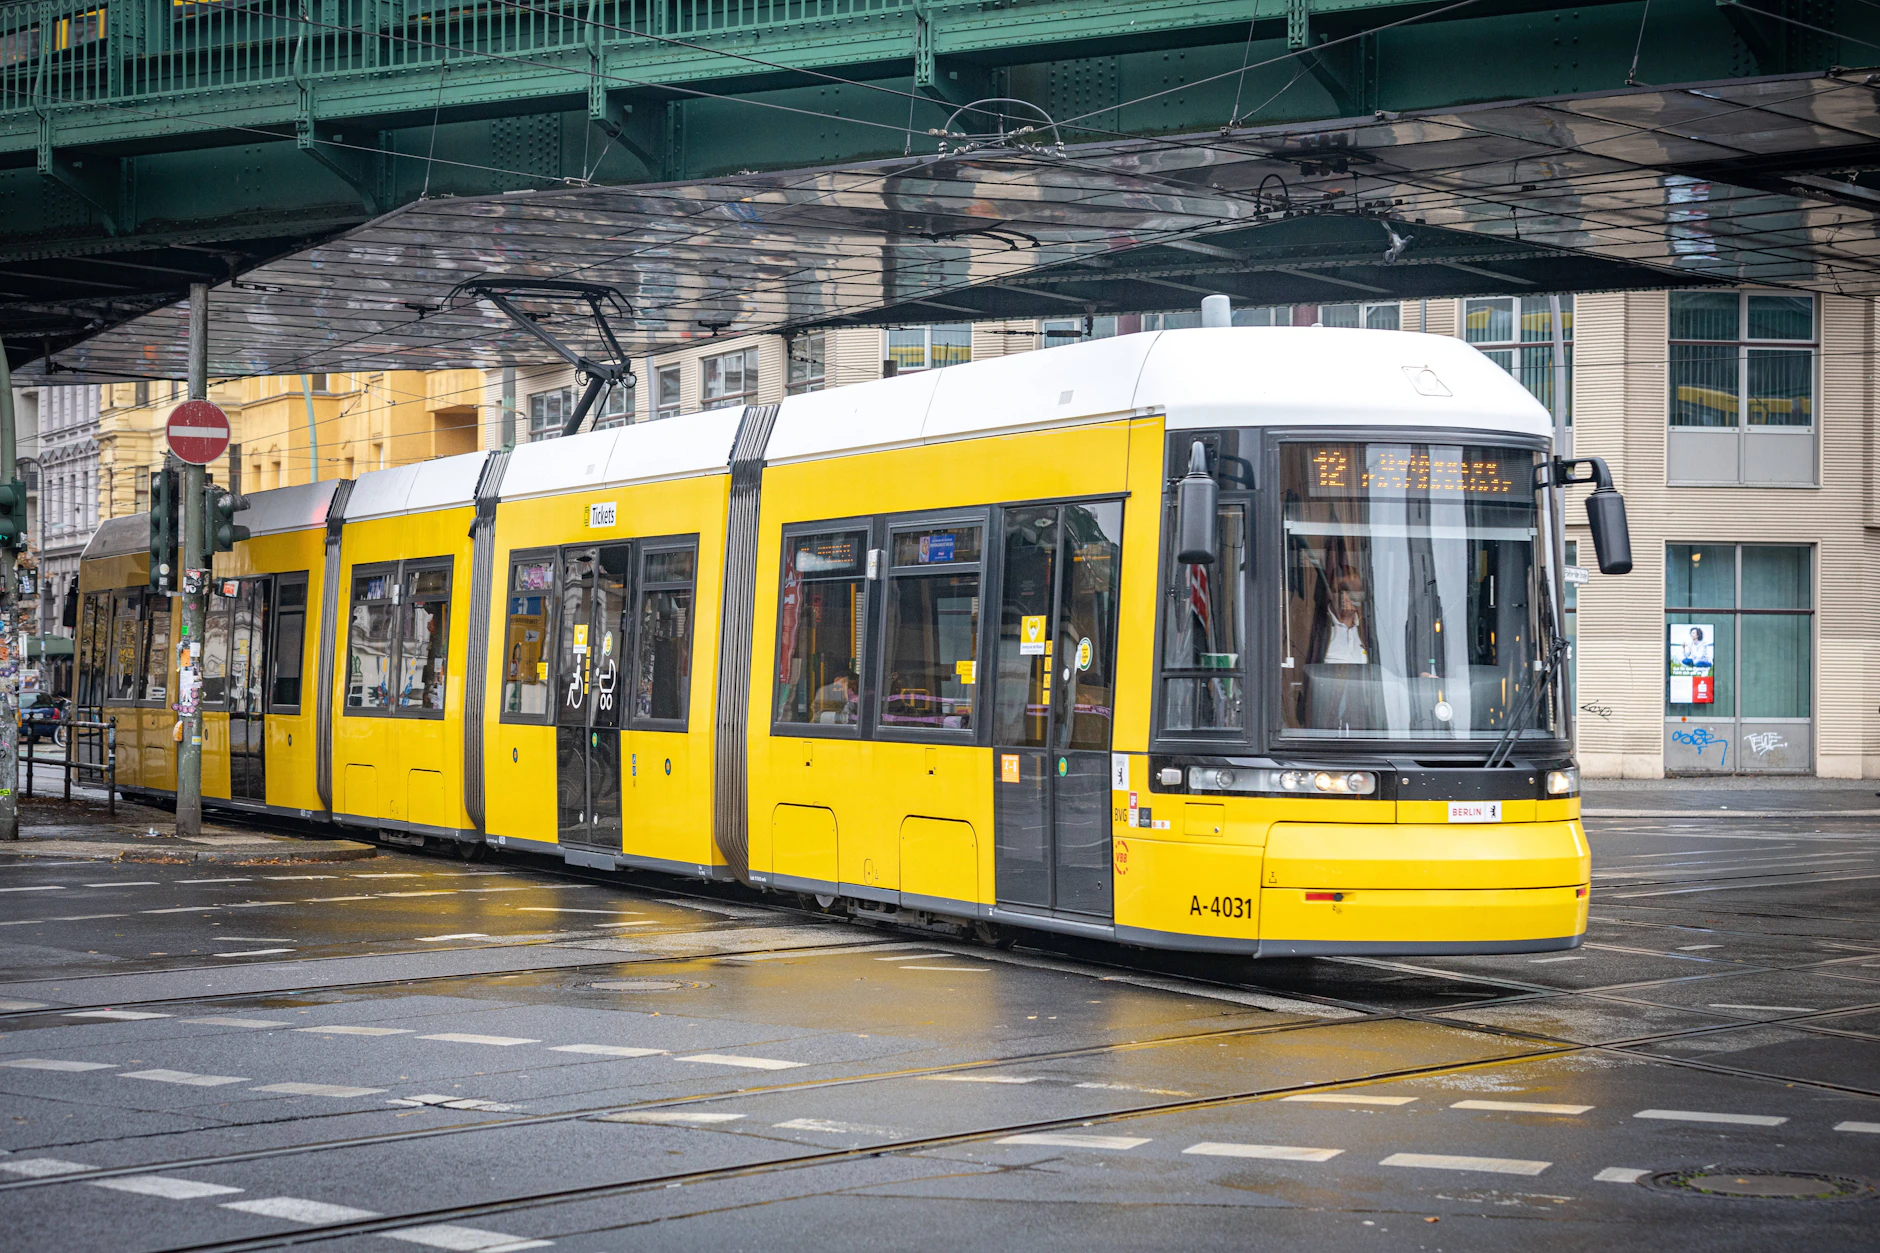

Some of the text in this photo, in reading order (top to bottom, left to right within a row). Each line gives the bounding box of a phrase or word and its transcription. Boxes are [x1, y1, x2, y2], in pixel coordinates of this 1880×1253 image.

[592, 505, 615, 526] Tickets
[1114, 808, 1128, 822] BVG
[1452, 808, 1482, 816] BERLIN
[1115, 852, 1128, 863] VBB
[1190, 895, 1253, 919] A-4031
